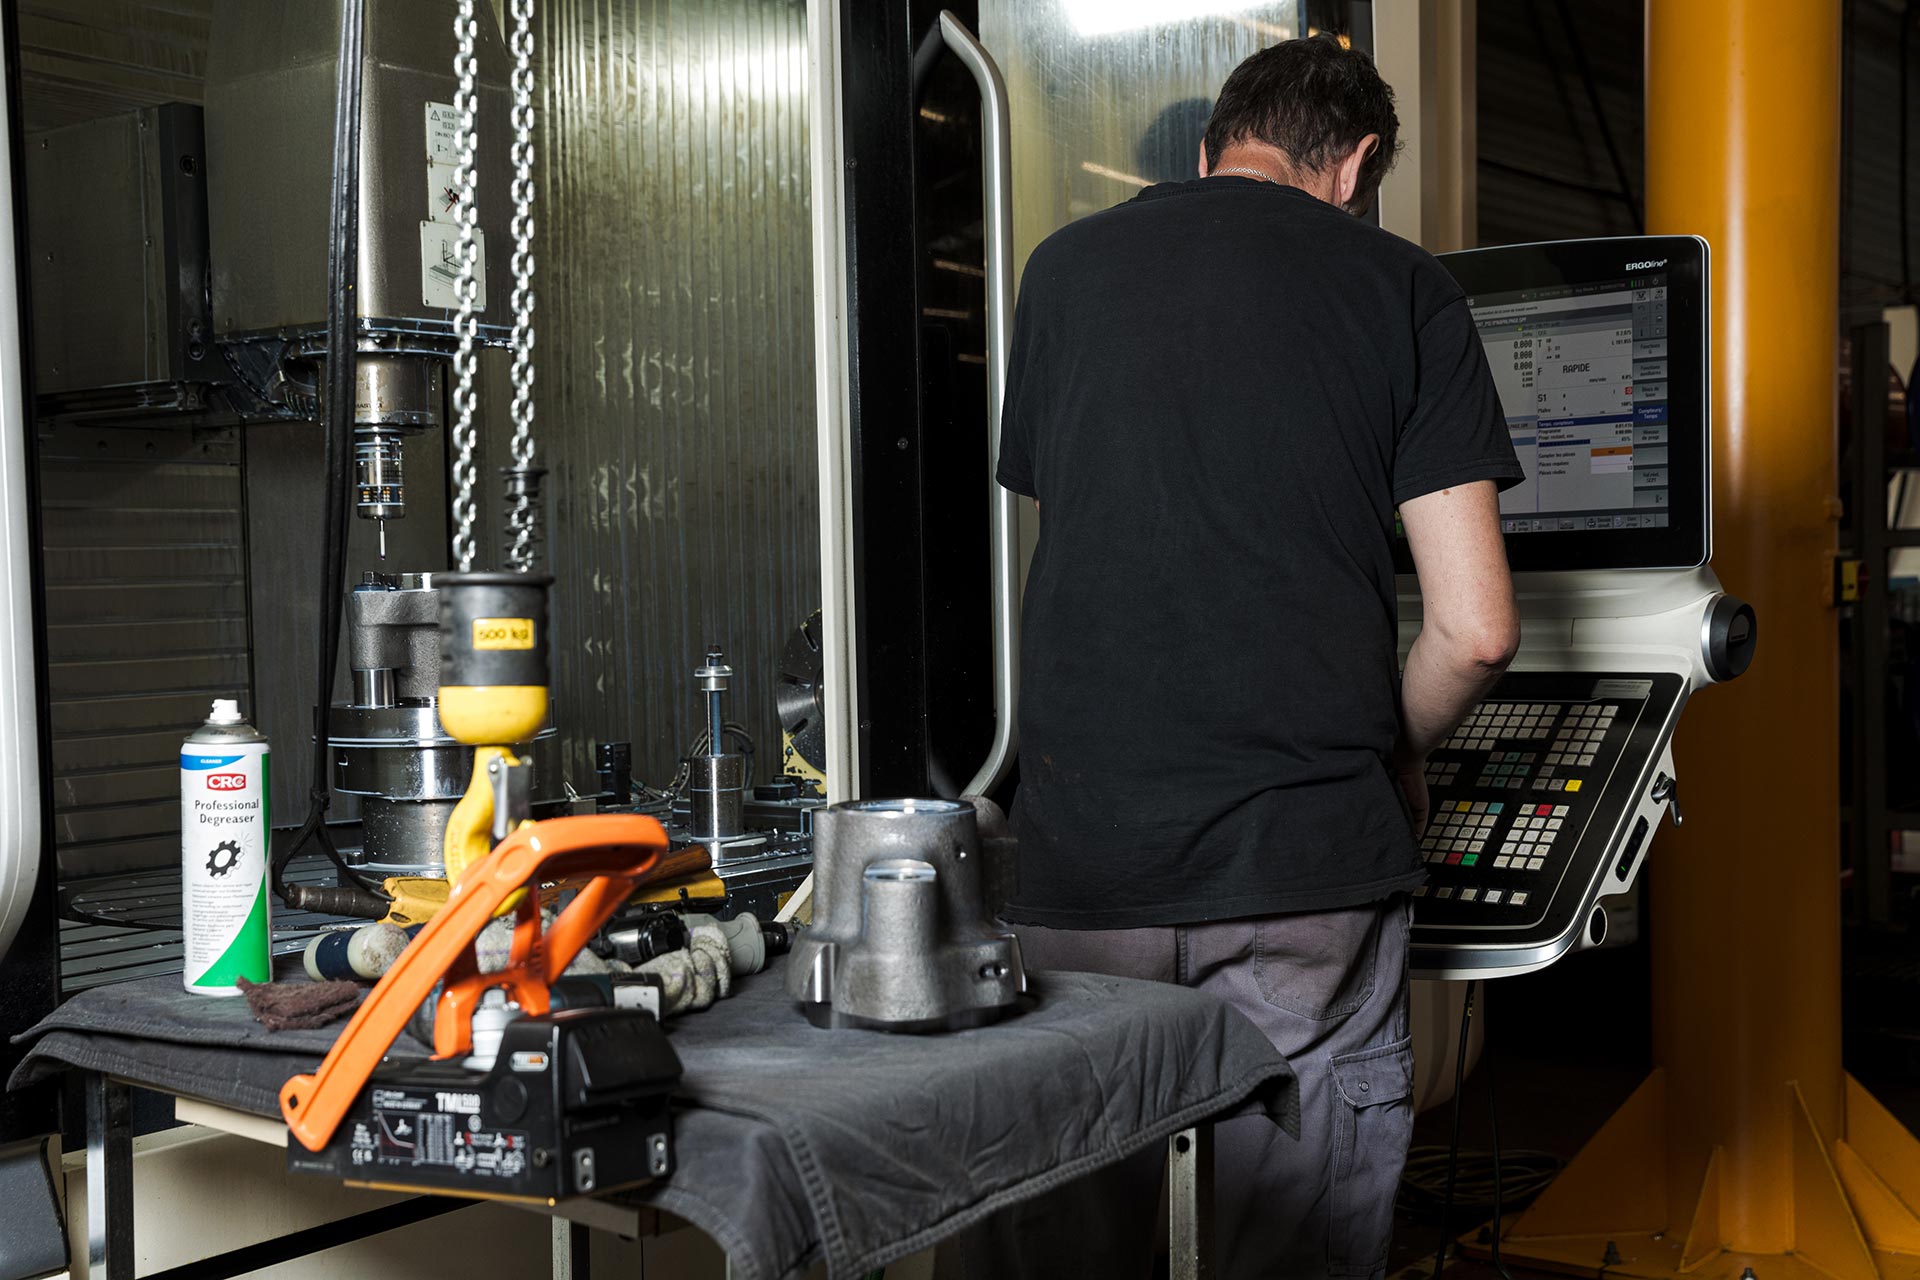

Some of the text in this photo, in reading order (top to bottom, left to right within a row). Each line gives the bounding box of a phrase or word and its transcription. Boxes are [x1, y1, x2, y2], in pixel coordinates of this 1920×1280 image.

[1562, 363, 1591, 375] RAPIDE
[479, 627, 529, 642] 500 kg
[208, 775, 246, 789] CRC
[195, 798, 260, 811] Professional
[199, 813, 255, 827] Degreaser
